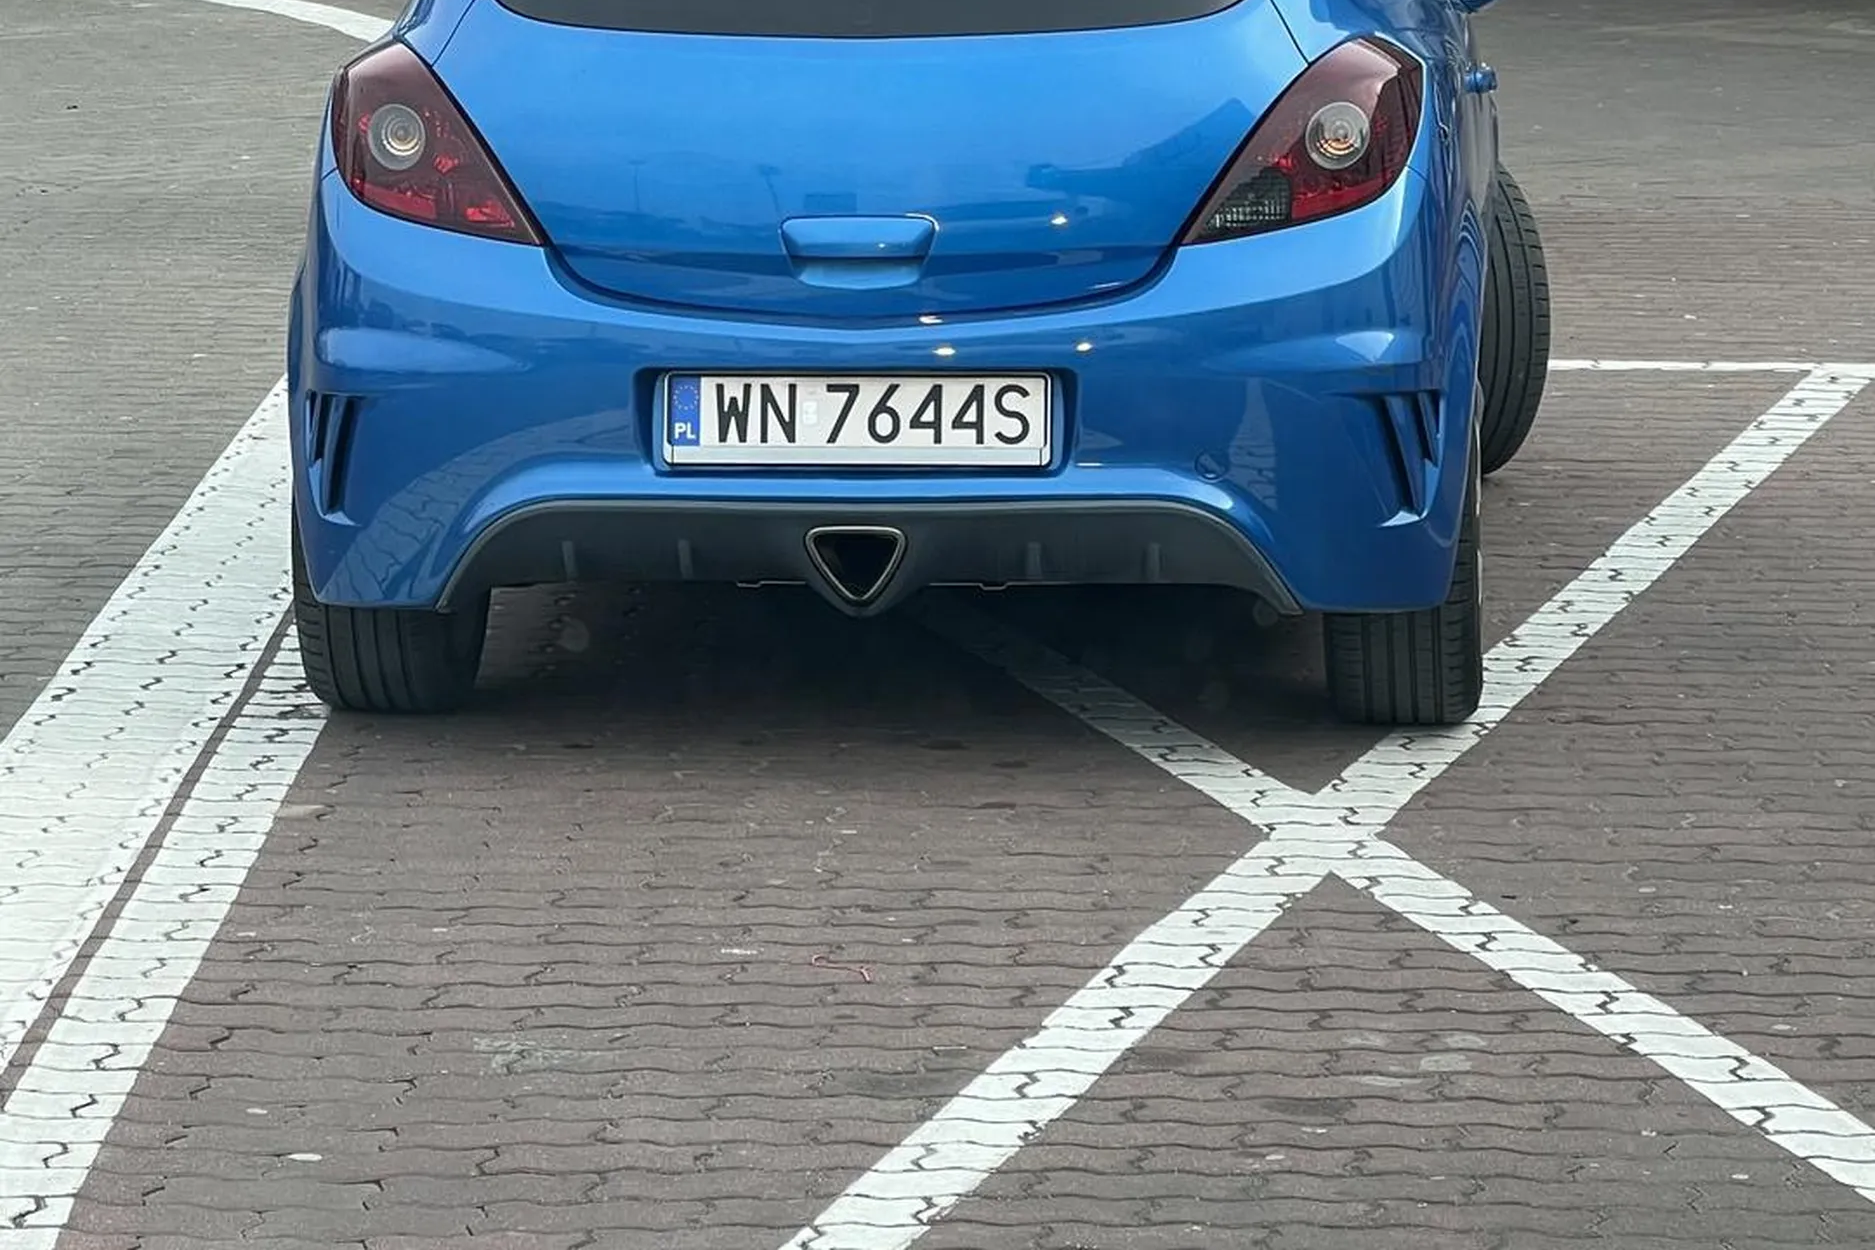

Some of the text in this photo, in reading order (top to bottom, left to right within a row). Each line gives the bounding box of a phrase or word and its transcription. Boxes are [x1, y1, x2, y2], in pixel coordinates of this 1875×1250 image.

[674, 422, 697, 440] PL
[715, 383, 1032, 445] WN 7644S
